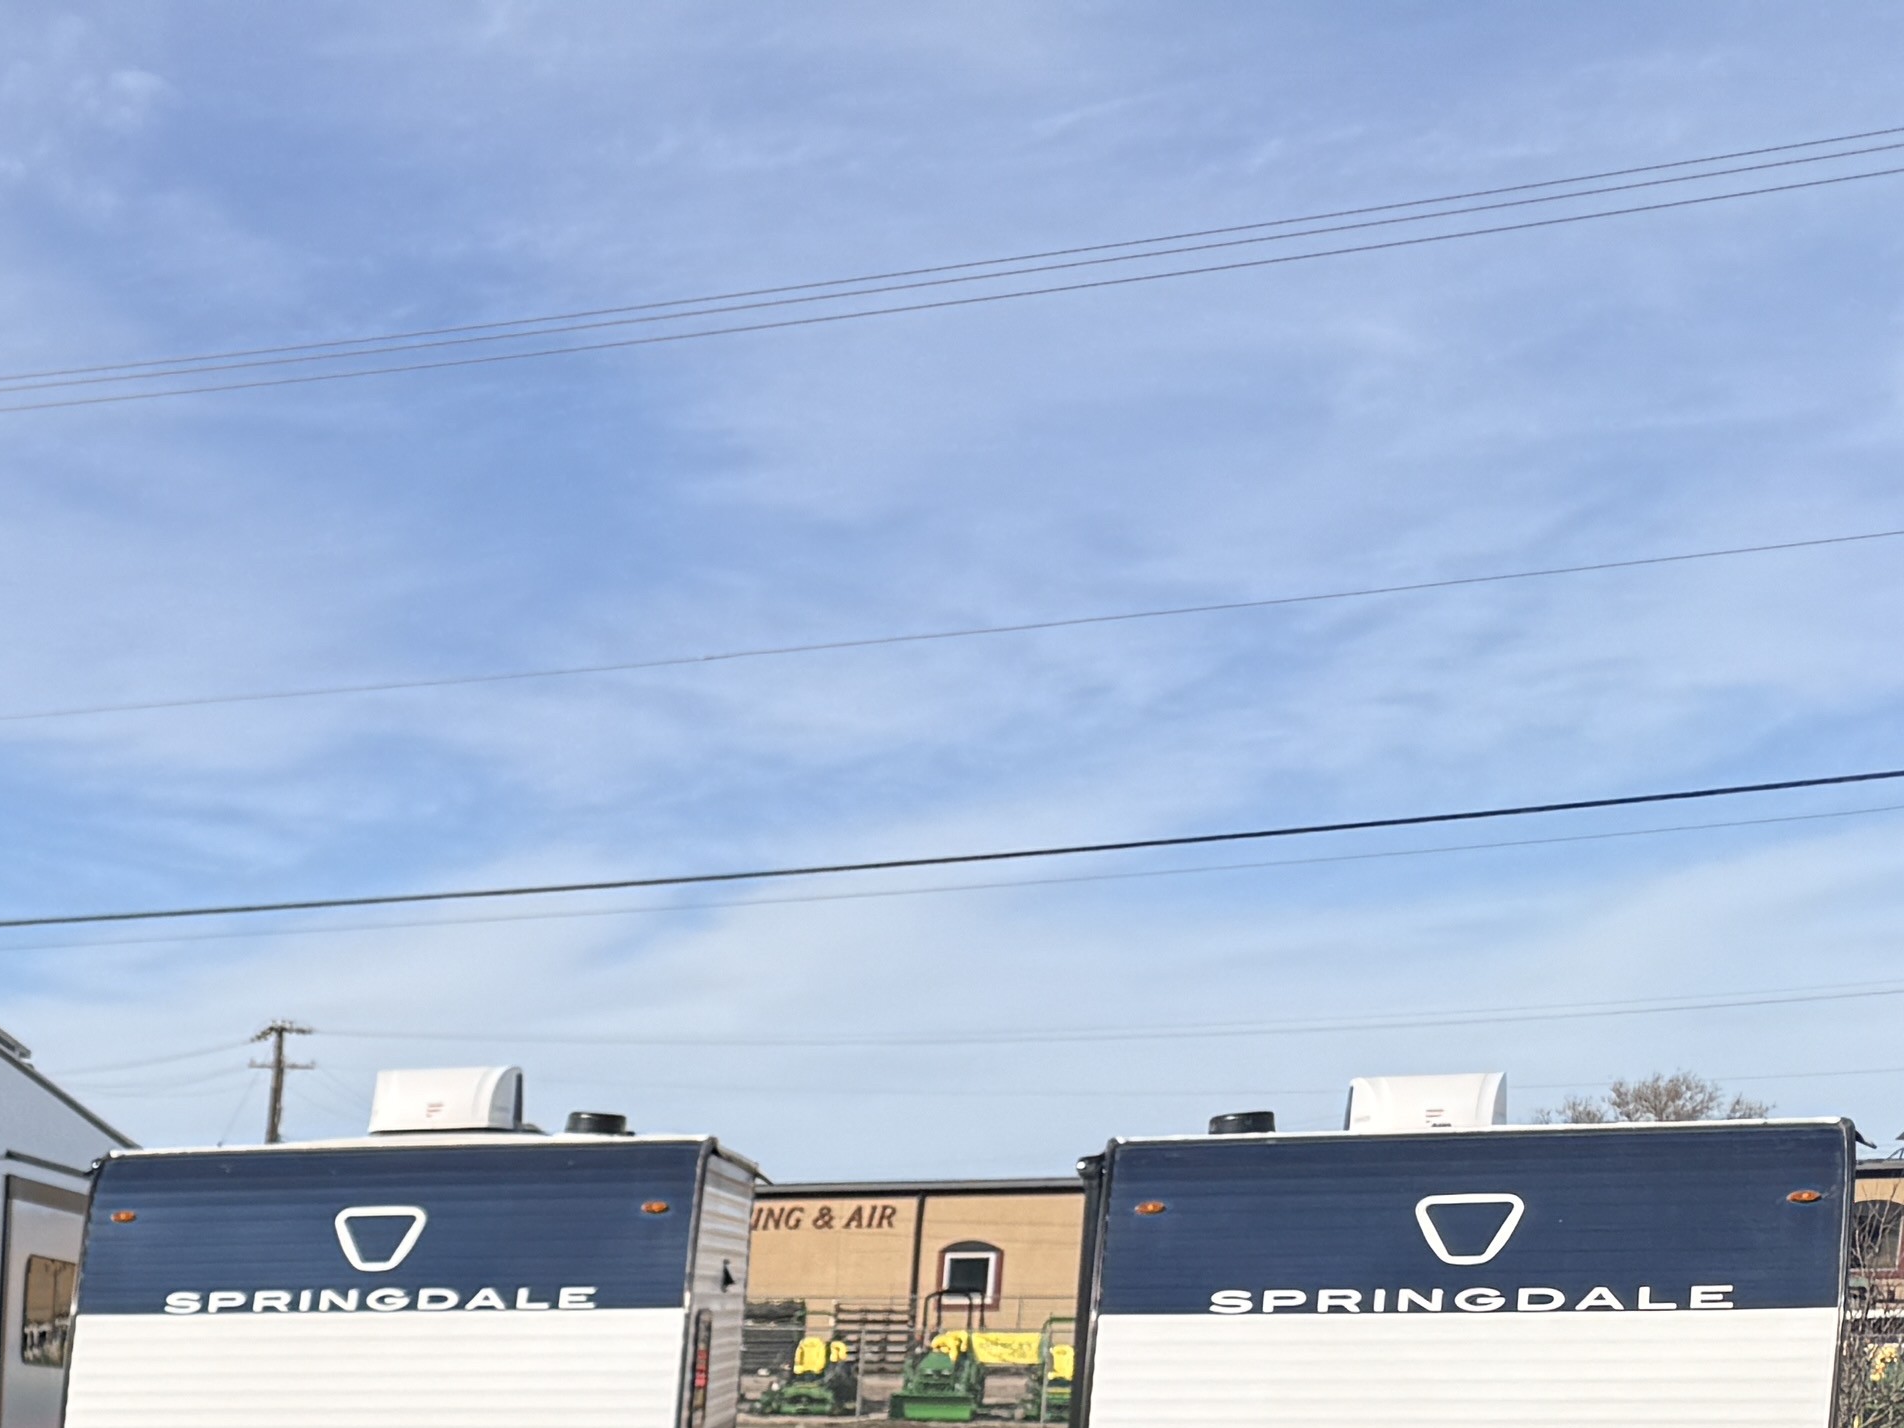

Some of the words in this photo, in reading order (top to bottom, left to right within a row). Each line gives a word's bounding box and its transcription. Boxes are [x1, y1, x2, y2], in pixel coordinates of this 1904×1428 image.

[812, 1205, 835, 1230] &
[843, 1204, 897, 1230] AIR
[163, 1286, 599, 1314] SPRINGDALE
[1208, 1284, 1734, 1314] SPRINGDALE
